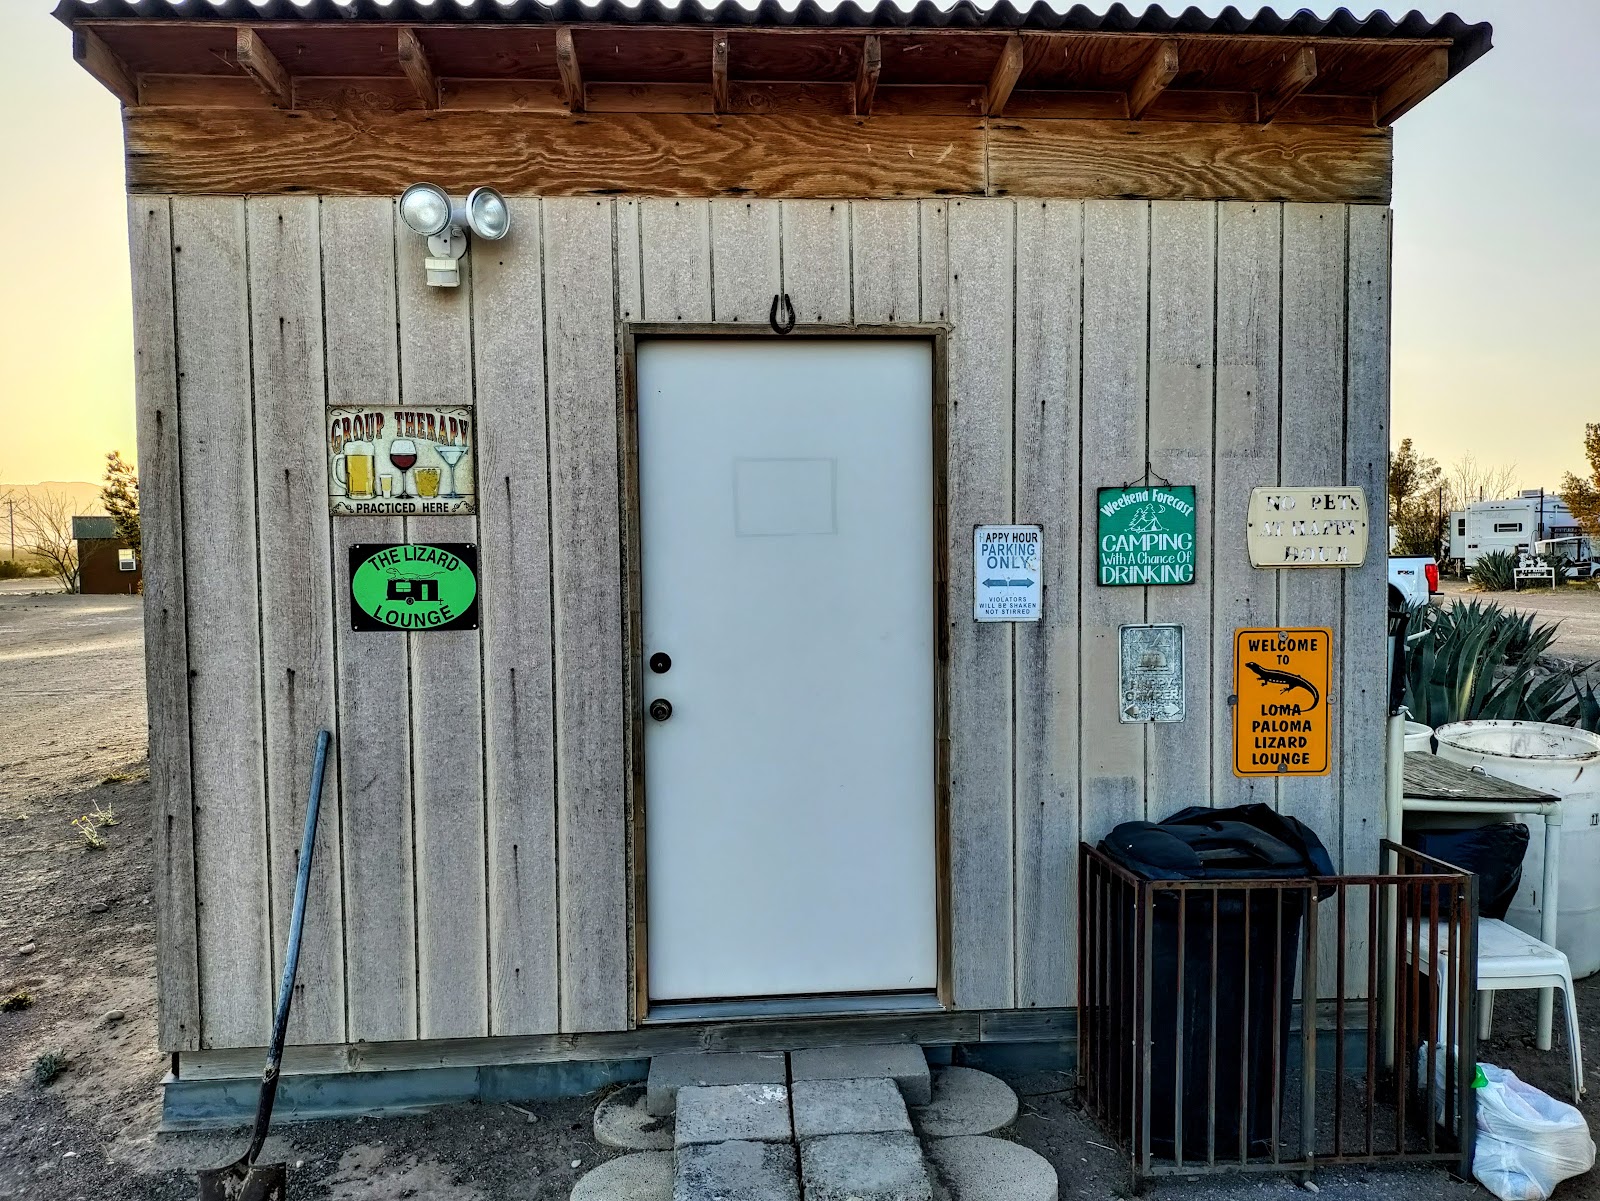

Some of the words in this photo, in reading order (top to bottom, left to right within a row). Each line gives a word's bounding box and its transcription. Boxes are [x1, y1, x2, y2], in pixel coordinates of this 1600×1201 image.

[331, 412, 385, 455] GROUP
[394, 411, 470, 448] THERAPY
[356, 503, 416, 514] PRACTICED
[422, 503, 449, 513] HERE
[1100, 490, 1149, 517] Weekend
[1152, 489, 1194, 517] Forecast
[1266, 495, 1296, 511] NO
[1311, 494, 1360, 511] PETS
[1257, 520, 1285, 537] AT
[1292, 519, 1360, 537] HAPPY
[1012, 532, 1038, 543] HOUR
[1102, 532, 1193, 552] CAMPING
[981, 543, 1035, 556] PARKING
[367, 549, 401, 571] THE
[403, 546, 460, 572] LIZARD
[986, 556, 1031, 570] ONLY
[1102, 552, 1127, 565] With
[1128, 553, 1136, 565] A
[1137, 551, 1175, 565] Chance
[1176, 550, 1192, 564] Of
[1102, 563, 1194, 585] DRINKING
[373, 604, 455, 628] LOUNGE
[1248, 638, 1318, 652] WELCOME
[1276, 654, 1290, 665] TO
[1261, 703, 1302, 717] LOMA
[1252, 719, 1312, 733] PALOMA
[1254, 736, 1308, 749] LIZARD
[1252, 752, 1310, 765] LOUNGE
